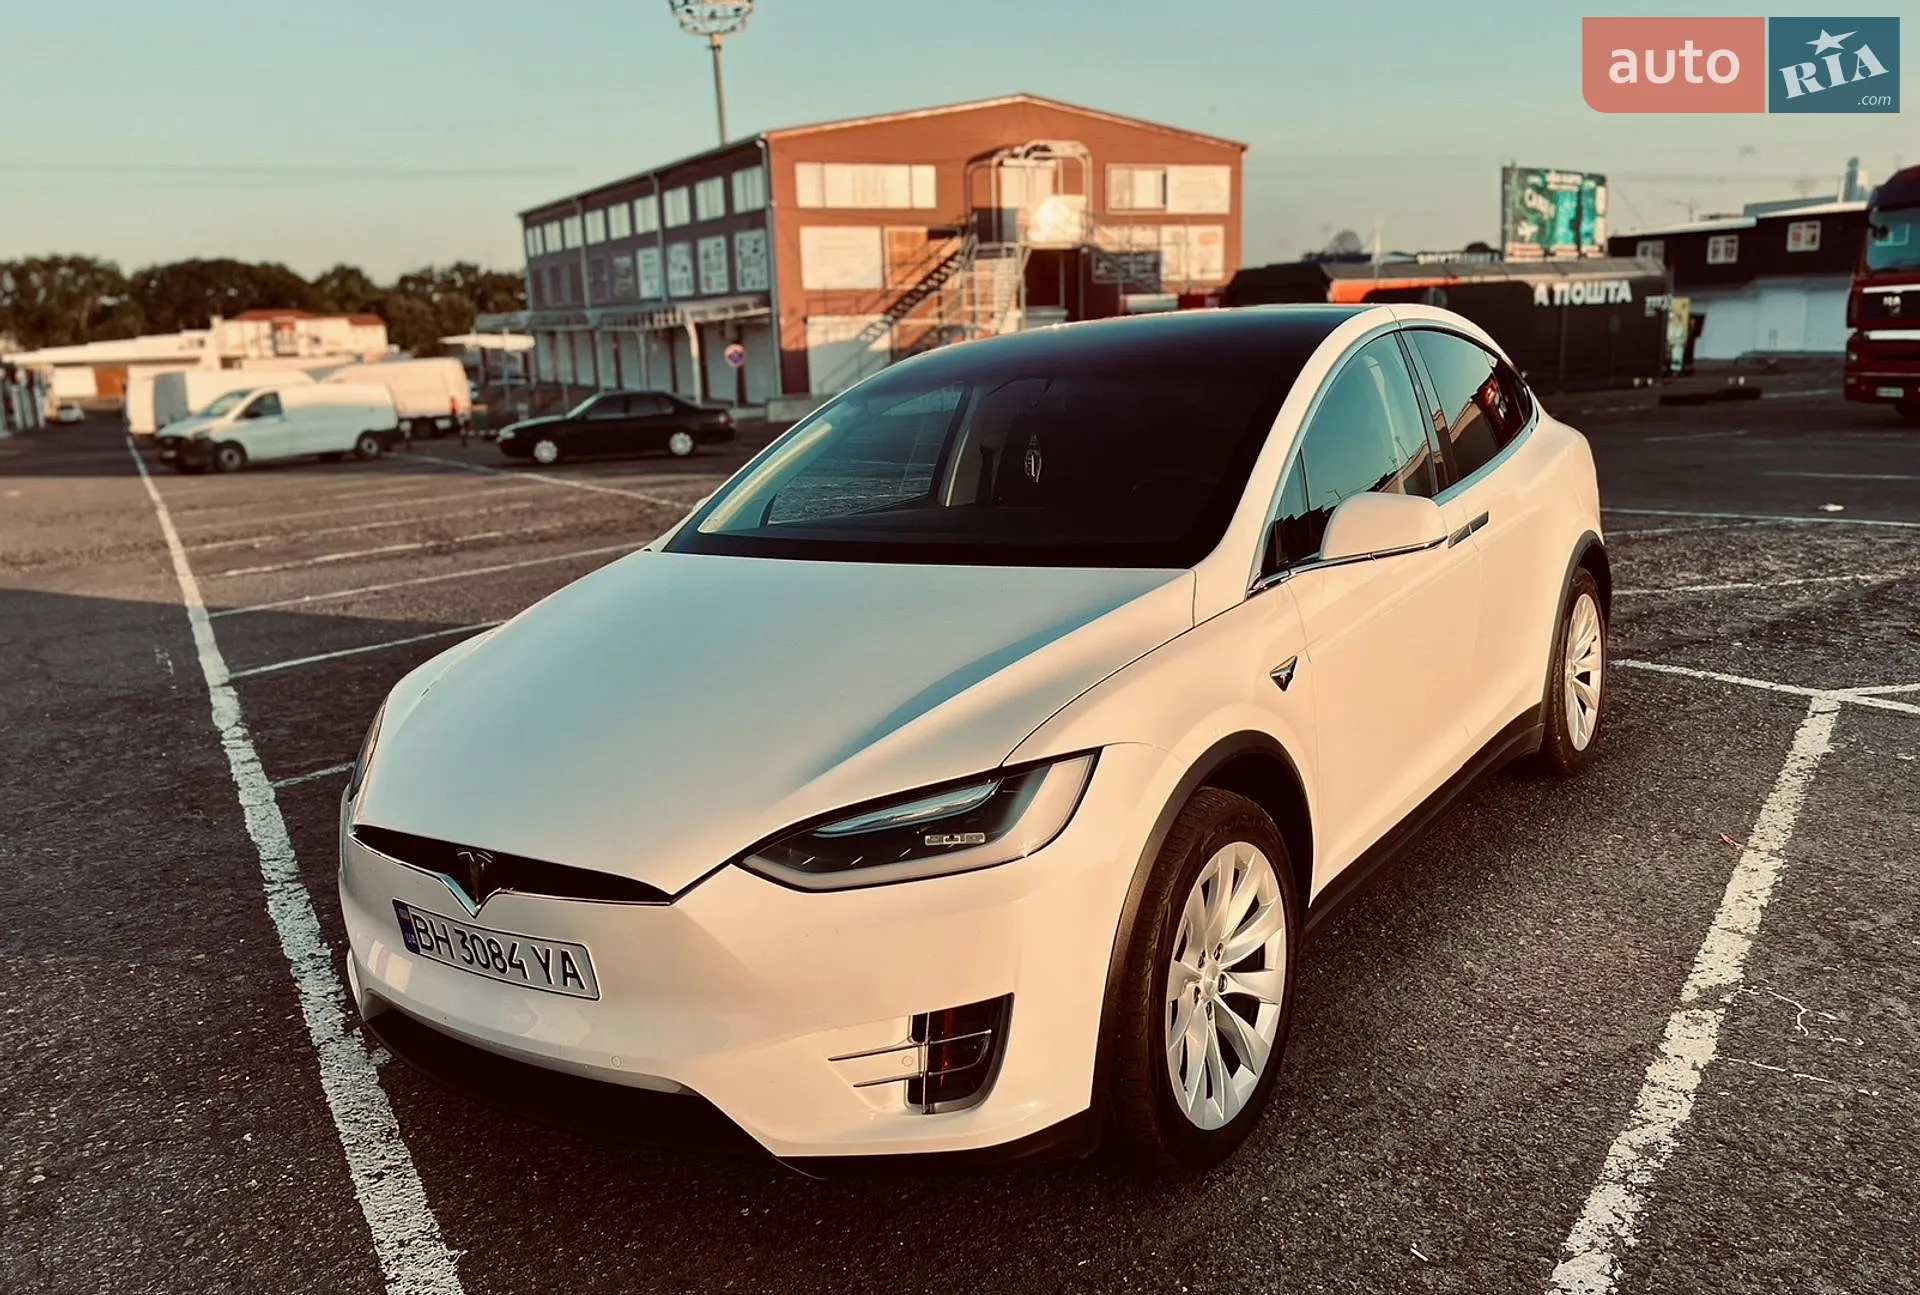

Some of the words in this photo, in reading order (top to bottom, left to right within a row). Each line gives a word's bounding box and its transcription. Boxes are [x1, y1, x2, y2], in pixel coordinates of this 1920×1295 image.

[1553, 280, 1632, 306] ПОШТА
[411, 913, 457, 959] BH
[454, 928, 530, 980] 3084
[531, 943, 587, 990] YA
